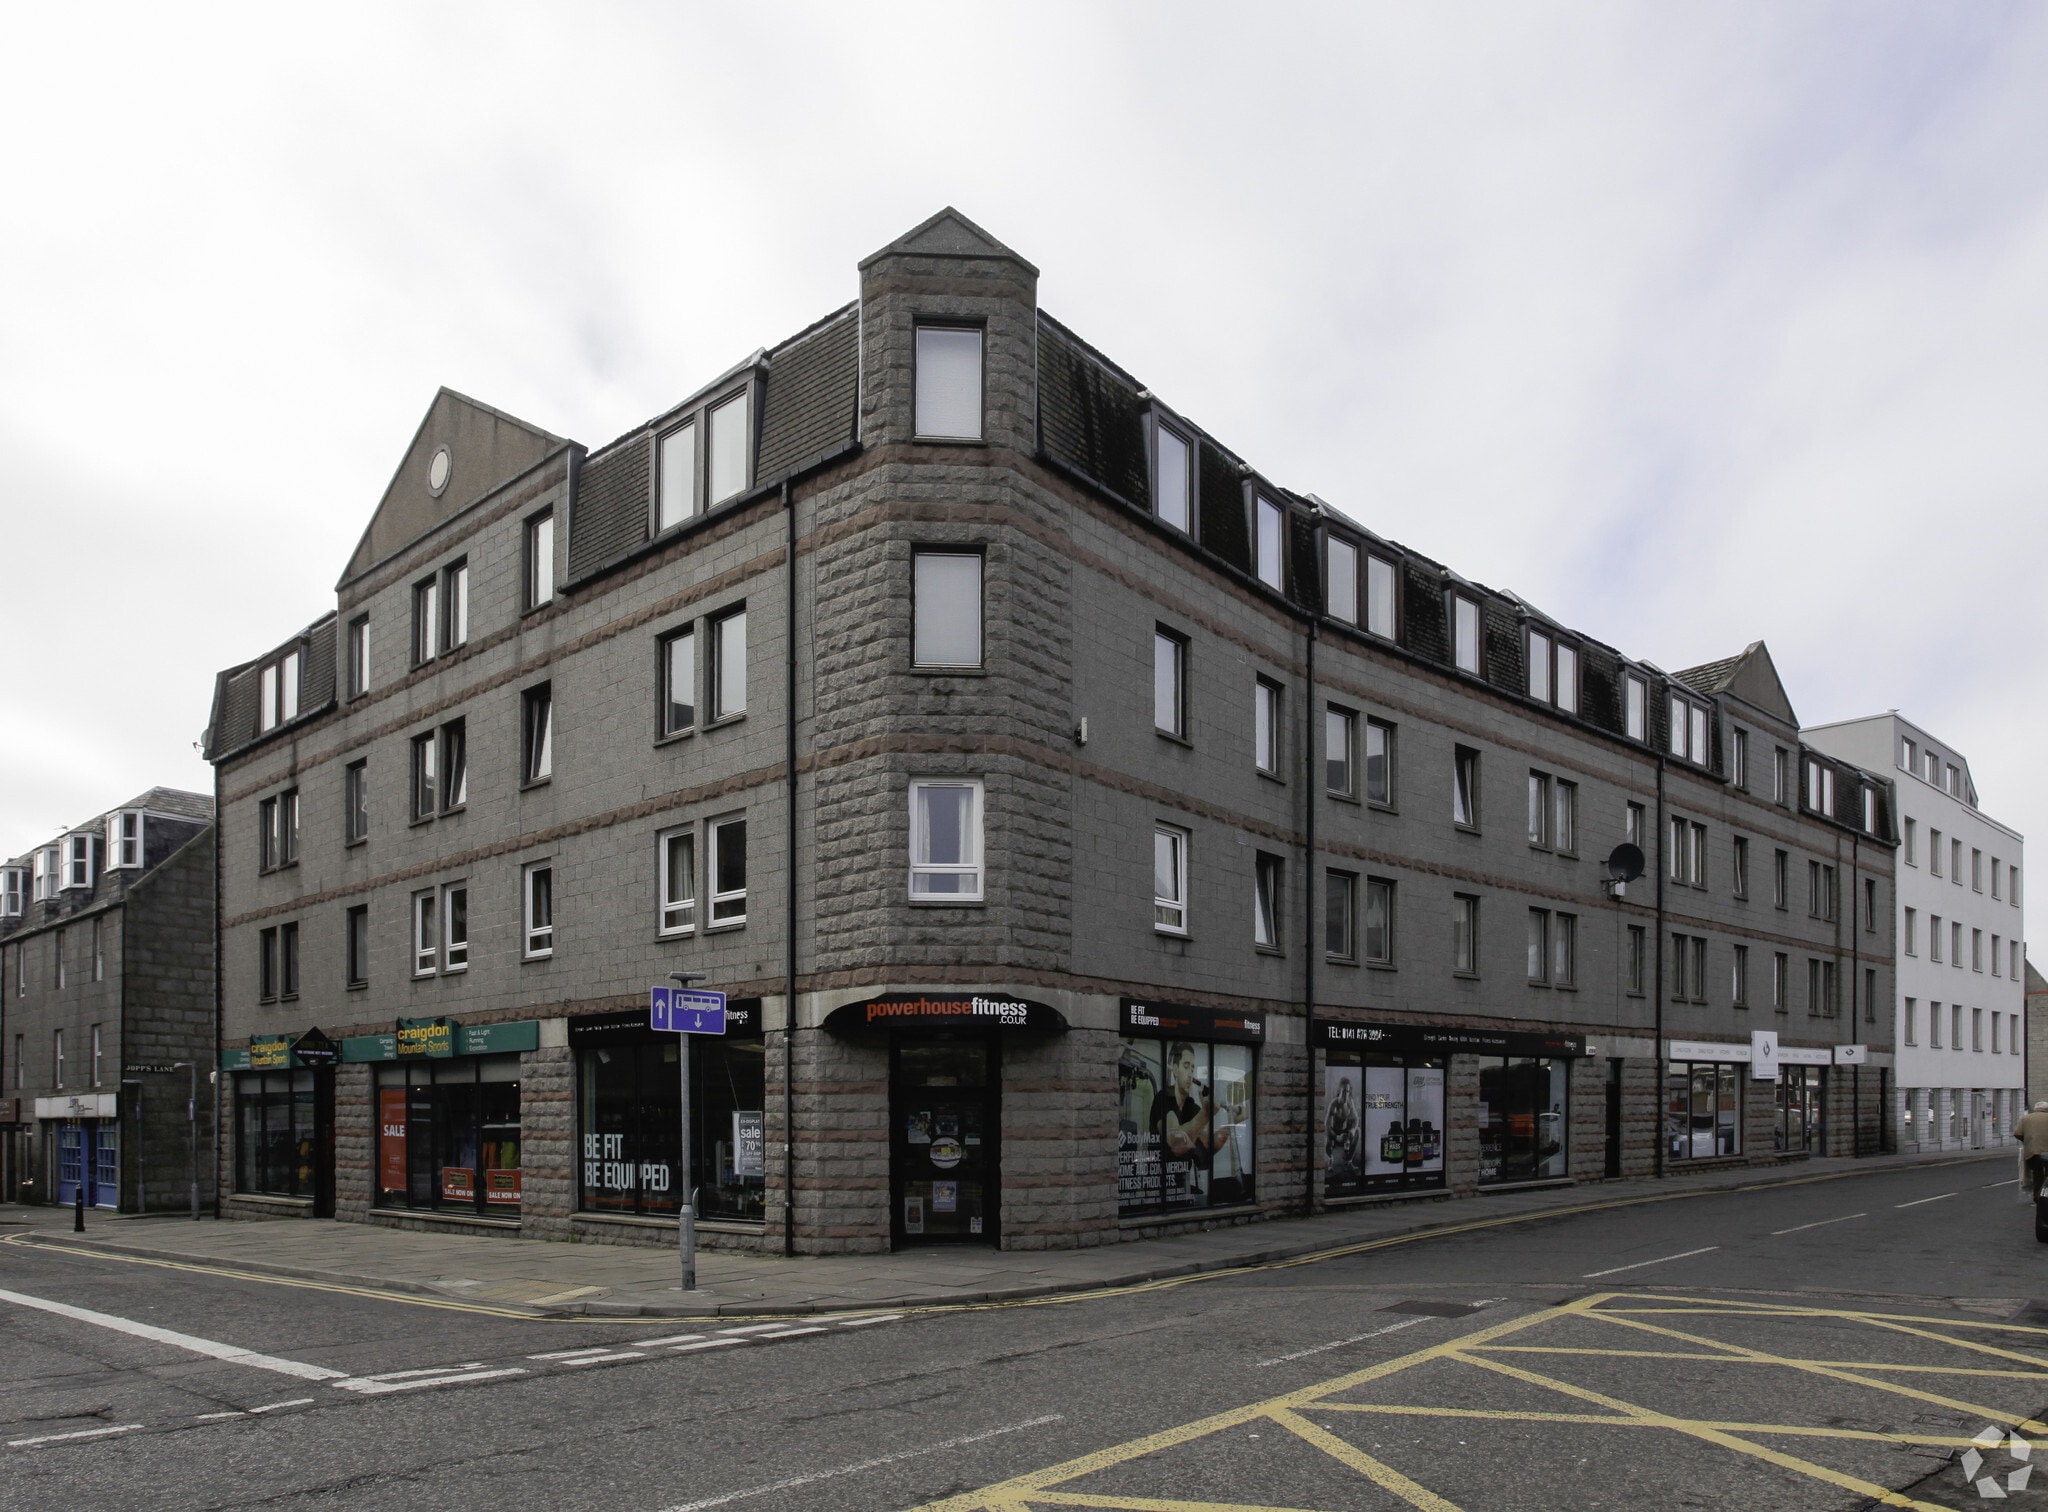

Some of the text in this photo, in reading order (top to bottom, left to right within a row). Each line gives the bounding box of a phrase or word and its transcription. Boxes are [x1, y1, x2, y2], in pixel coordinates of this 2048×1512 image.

[1130, 1004, 1145, 1015] BE FIT
[1130, 1014, 1137, 1024] BE
[1137, 1015, 1159, 1026] EQUIPPED
[397, 1023, 450, 1041] craigdon
[1327, 1026, 1341, 1039] TEL:
[251, 1040, 288, 1055] craigdon
[397, 1040, 450, 1055] Mountain Sports
[251, 1054, 288, 1066] Mountain Sports
[384, 1124, 405, 1137] SALE
[740, 1125, 760, 1139] sale
[1127, 1131, 1160, 1146] BodyMax
[584, 1133, 623, 1160] BE FIT
[584, 1162, 600, 1188] BE
[1135, 1163, 1149, 1175] AND
[1481, 1168, 1497, 1176] HOME
[466, 1190, 474, 1198] ON
